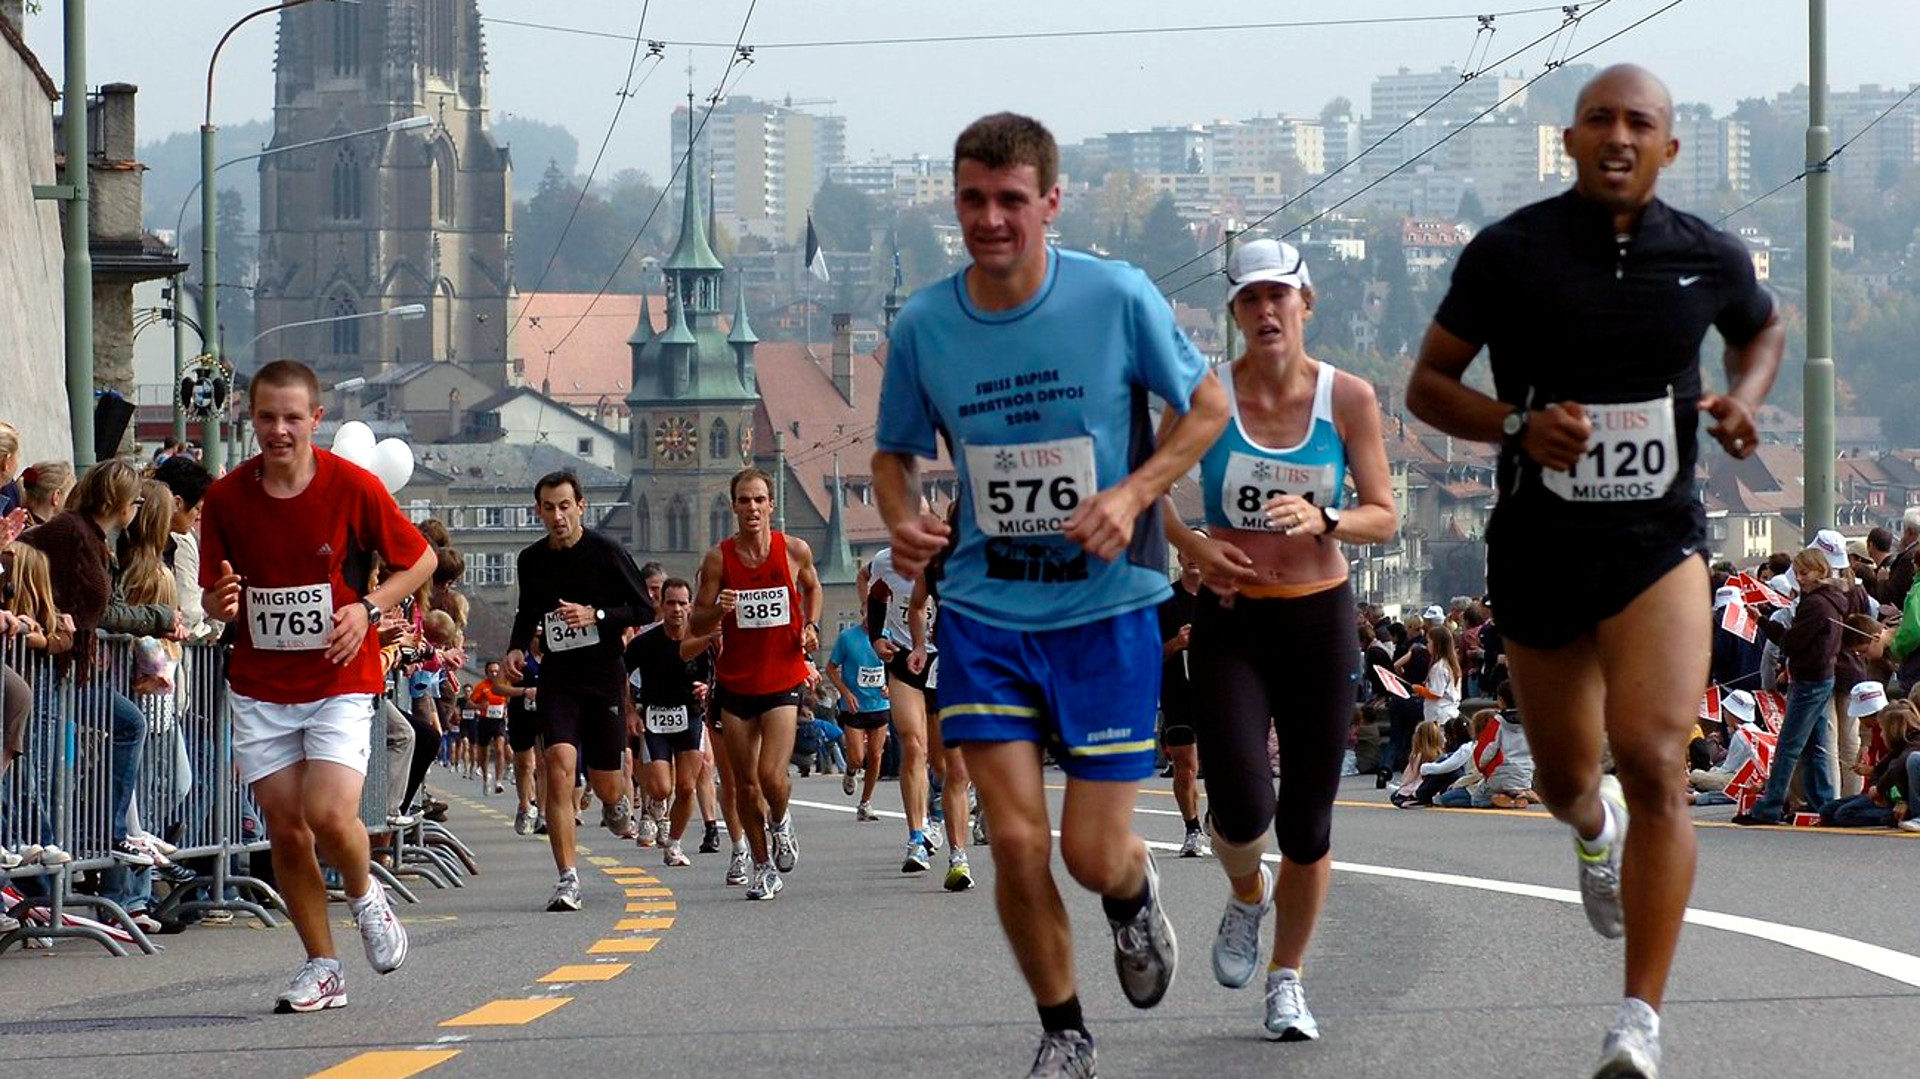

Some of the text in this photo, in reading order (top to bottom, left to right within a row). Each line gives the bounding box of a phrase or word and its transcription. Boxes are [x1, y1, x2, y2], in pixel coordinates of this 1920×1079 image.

[976, 369, 1059, 396] SWISS ALPINE
[959, 385, 1084, 418] MARATHON DAVOS
[1606, 410, 1648, 430] UBS
[1021, 446, 1062, 468] UBS
[1276, 465, 1309, 483] UBS
[988, 476, 1079, 514] 576
[1572, 481, 1655, 499] MIGROS
[252, 589, 323, 606] MIGROS
[739, 589, 784, 602] MIGROS
[743, 602, 782, 619] 385
[256, 609, 324, 636] 1763
[651, 714, 684, 727] 1293
